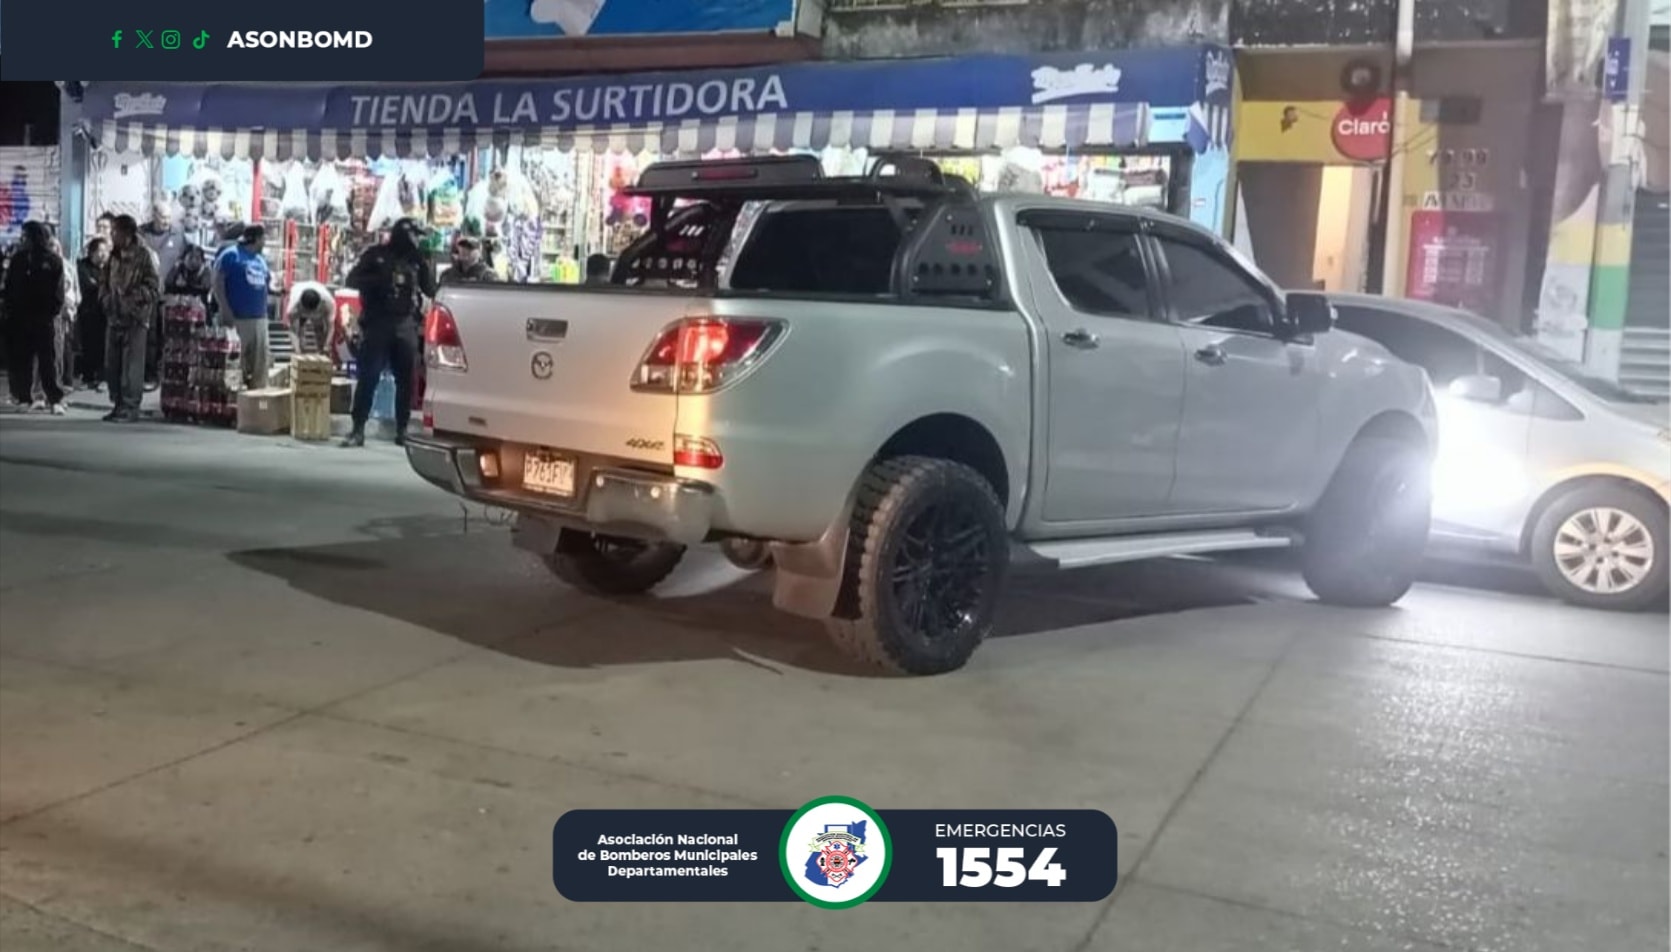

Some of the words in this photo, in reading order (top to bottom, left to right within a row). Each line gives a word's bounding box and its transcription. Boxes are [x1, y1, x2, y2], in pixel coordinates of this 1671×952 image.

[350, 93, 479, 125] TIENDA
[493, 91, 538, 123] LA
[550, 74, 788, 122] SURTIDORA
[1338, 111, 1390, 136] Claro
